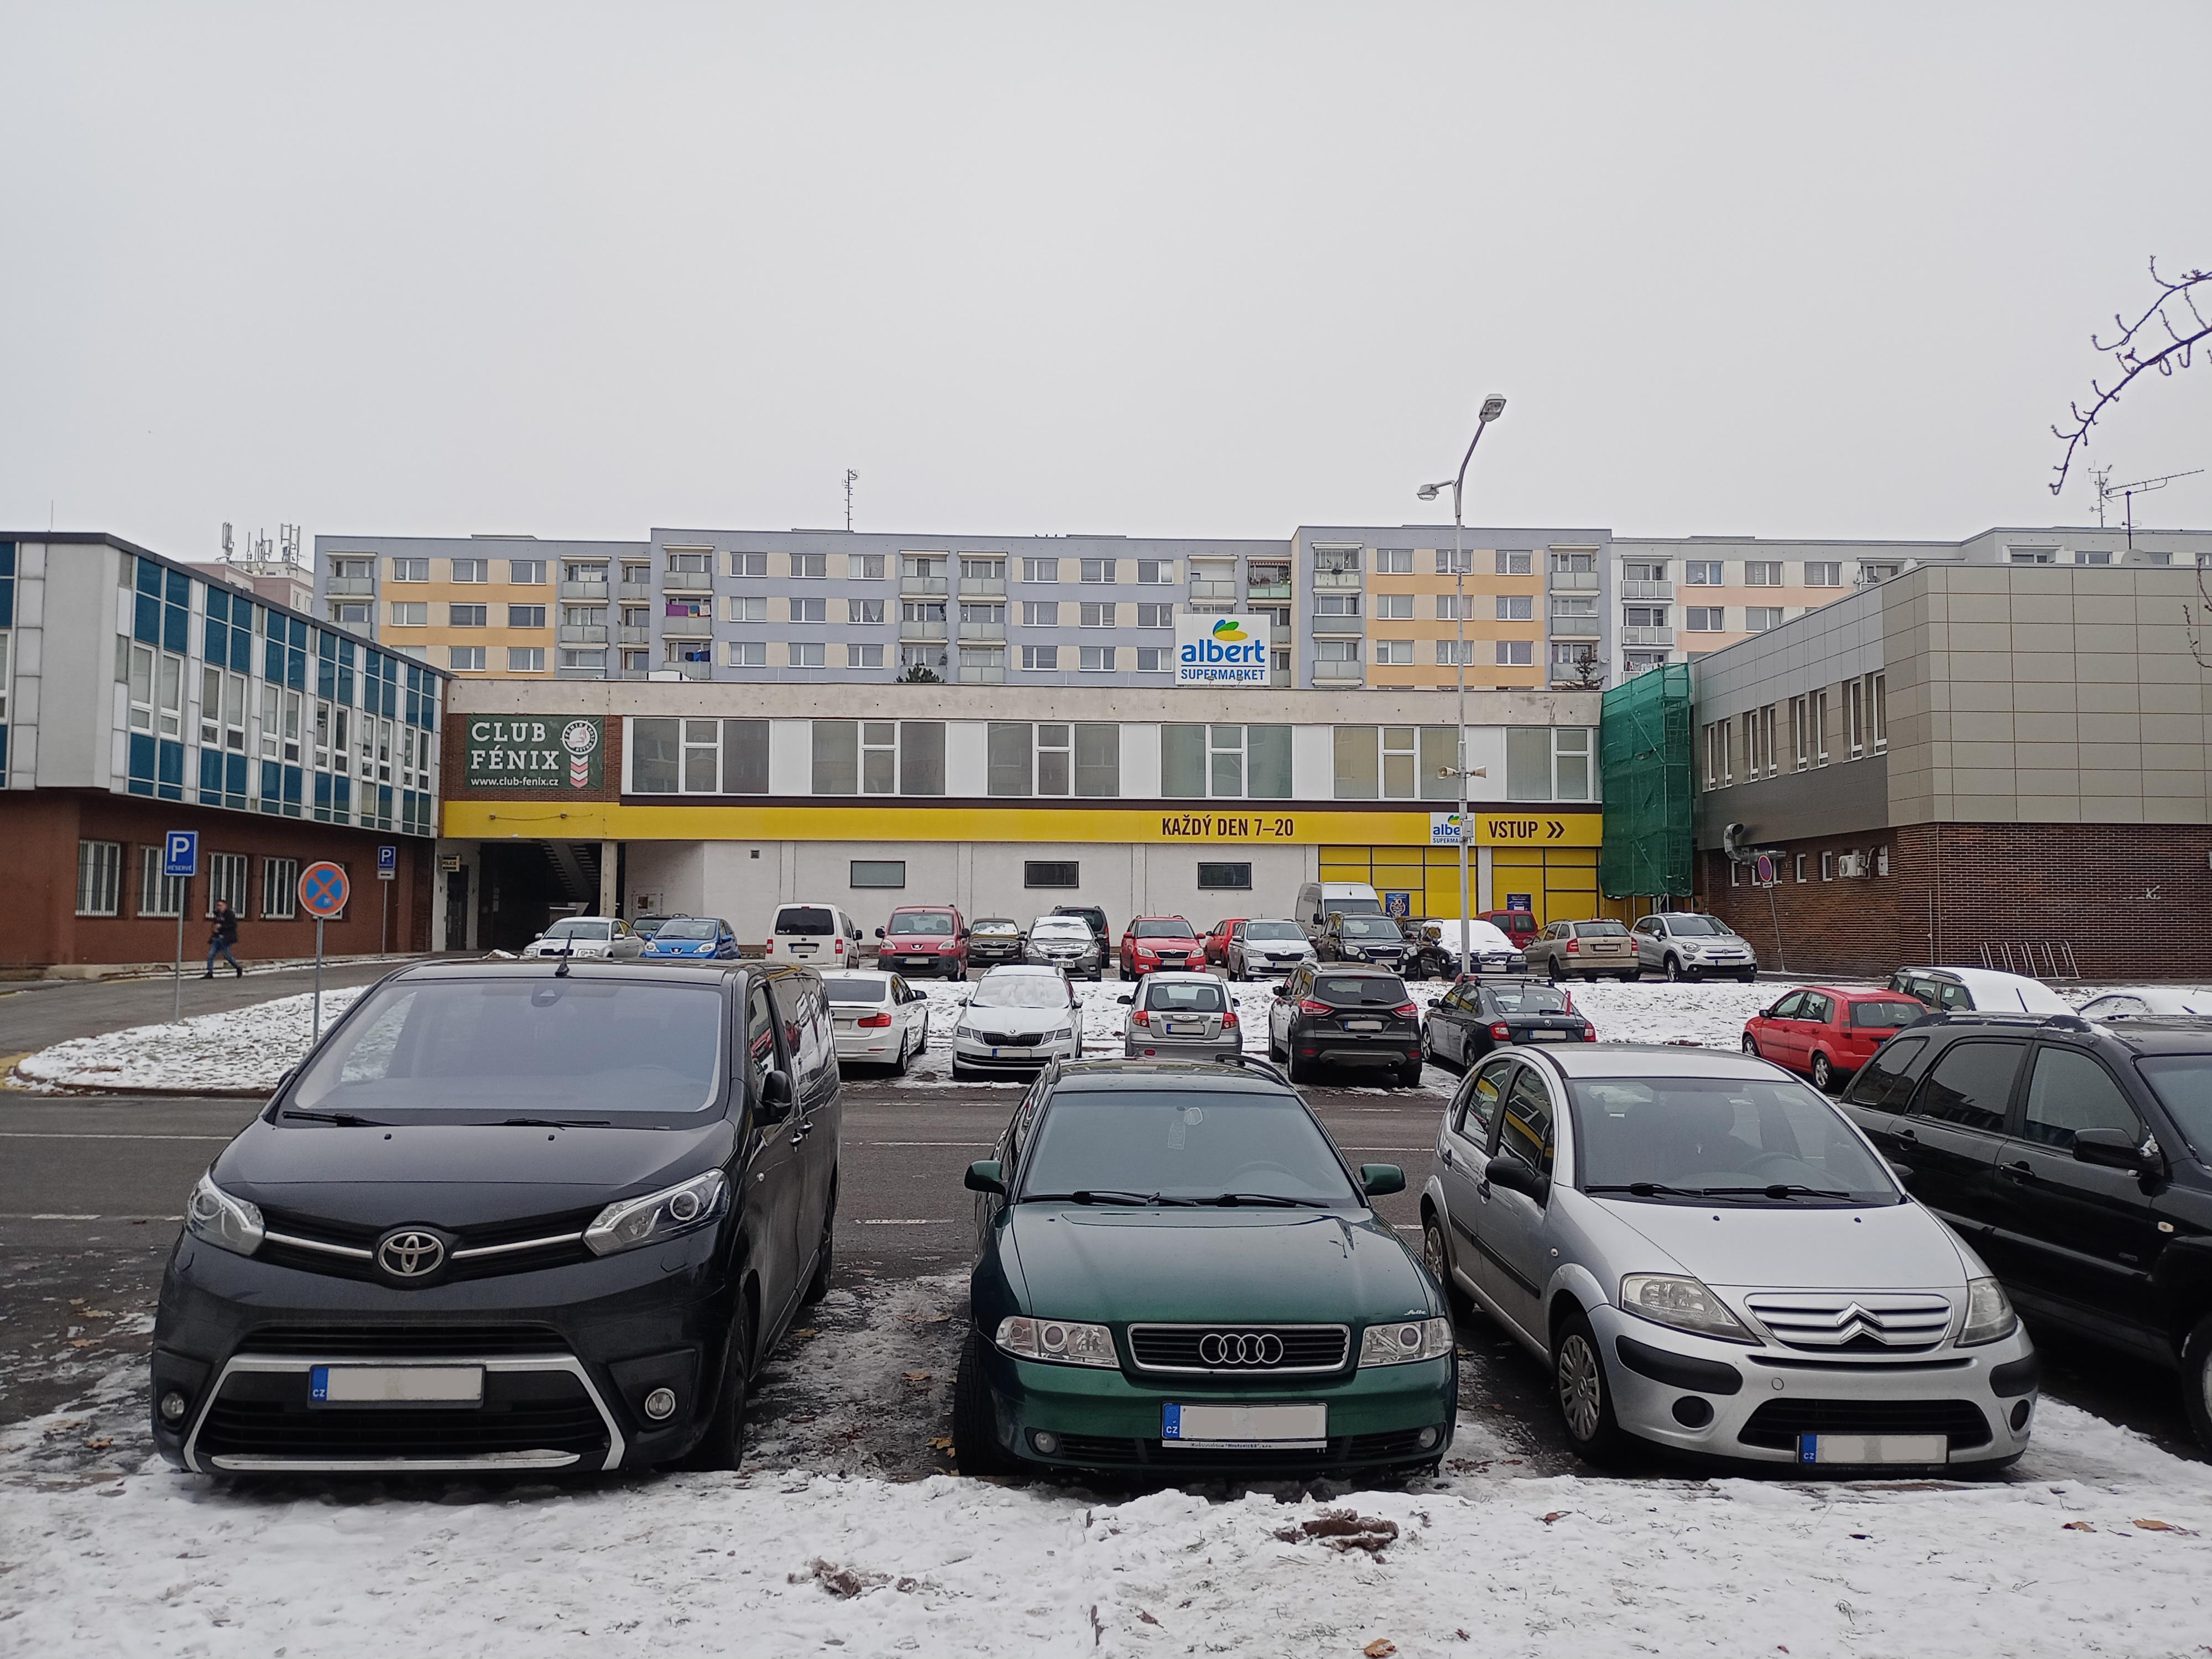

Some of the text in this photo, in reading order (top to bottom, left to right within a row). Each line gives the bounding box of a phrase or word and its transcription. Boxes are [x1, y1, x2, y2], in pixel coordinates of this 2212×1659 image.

[1181, 639, 1265, 662] albert
[1181, 669, 1265, 680] SUPERMARKET
[471, 722, 546, 742] CLUB
[471, 745, 559, 770] FÉNIX
[471, 776, 559, 786] www.club-fenix.cz
[1162, 814, 1212, 836] KAŽDÝ
[1217, 818, 1248, 836] DEN
[1433, 824, 1460, 835] albe
[1489, 821, 1538, 839] VSTUP
[171, 837, 190, 862] P
[382, 849, 392, 862] P
[312, 1389, 326, 1397] CZ
[1166, 1426, 1178, 1434] CZ
